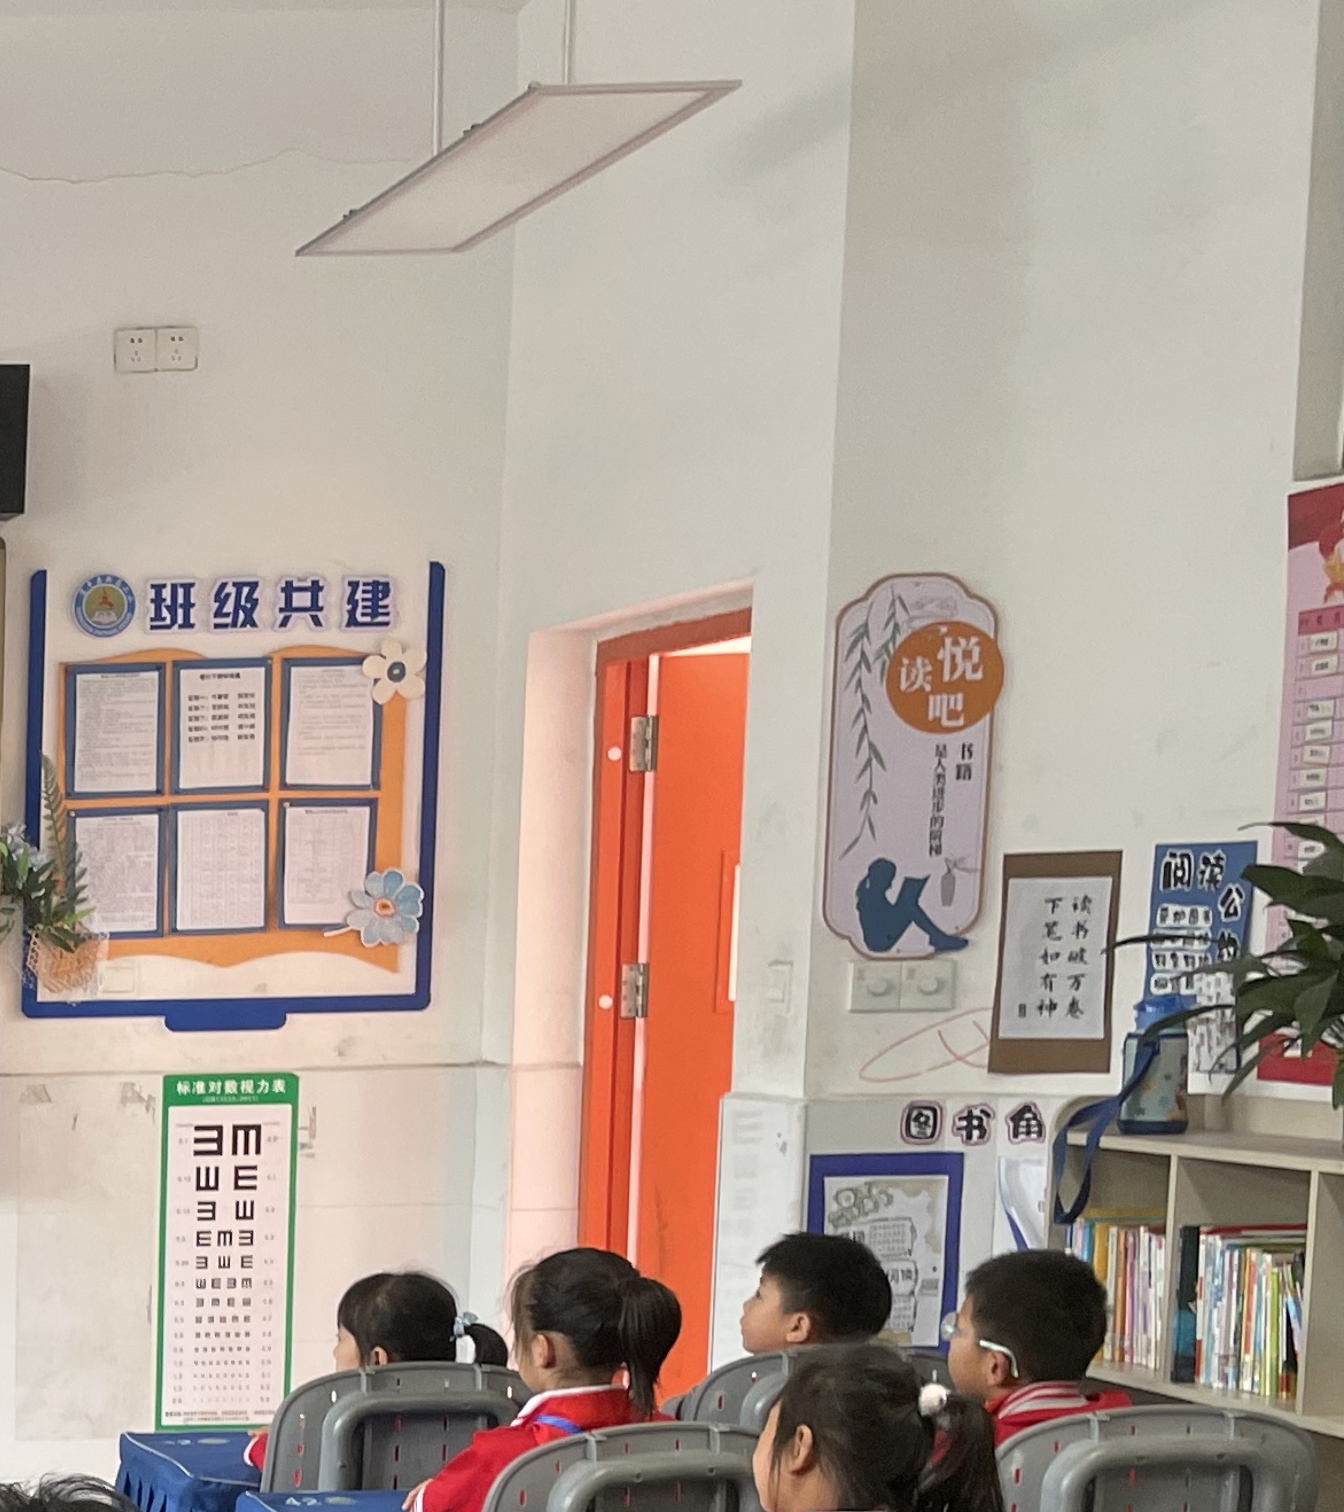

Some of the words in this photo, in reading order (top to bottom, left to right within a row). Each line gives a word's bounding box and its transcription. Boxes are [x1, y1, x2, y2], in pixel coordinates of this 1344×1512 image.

[149, 579, 391, 630] 班级共建
[176, 1078, 286, 1096] 标准对数视力表
[905, 1104, 1044, 1141] 图书角
